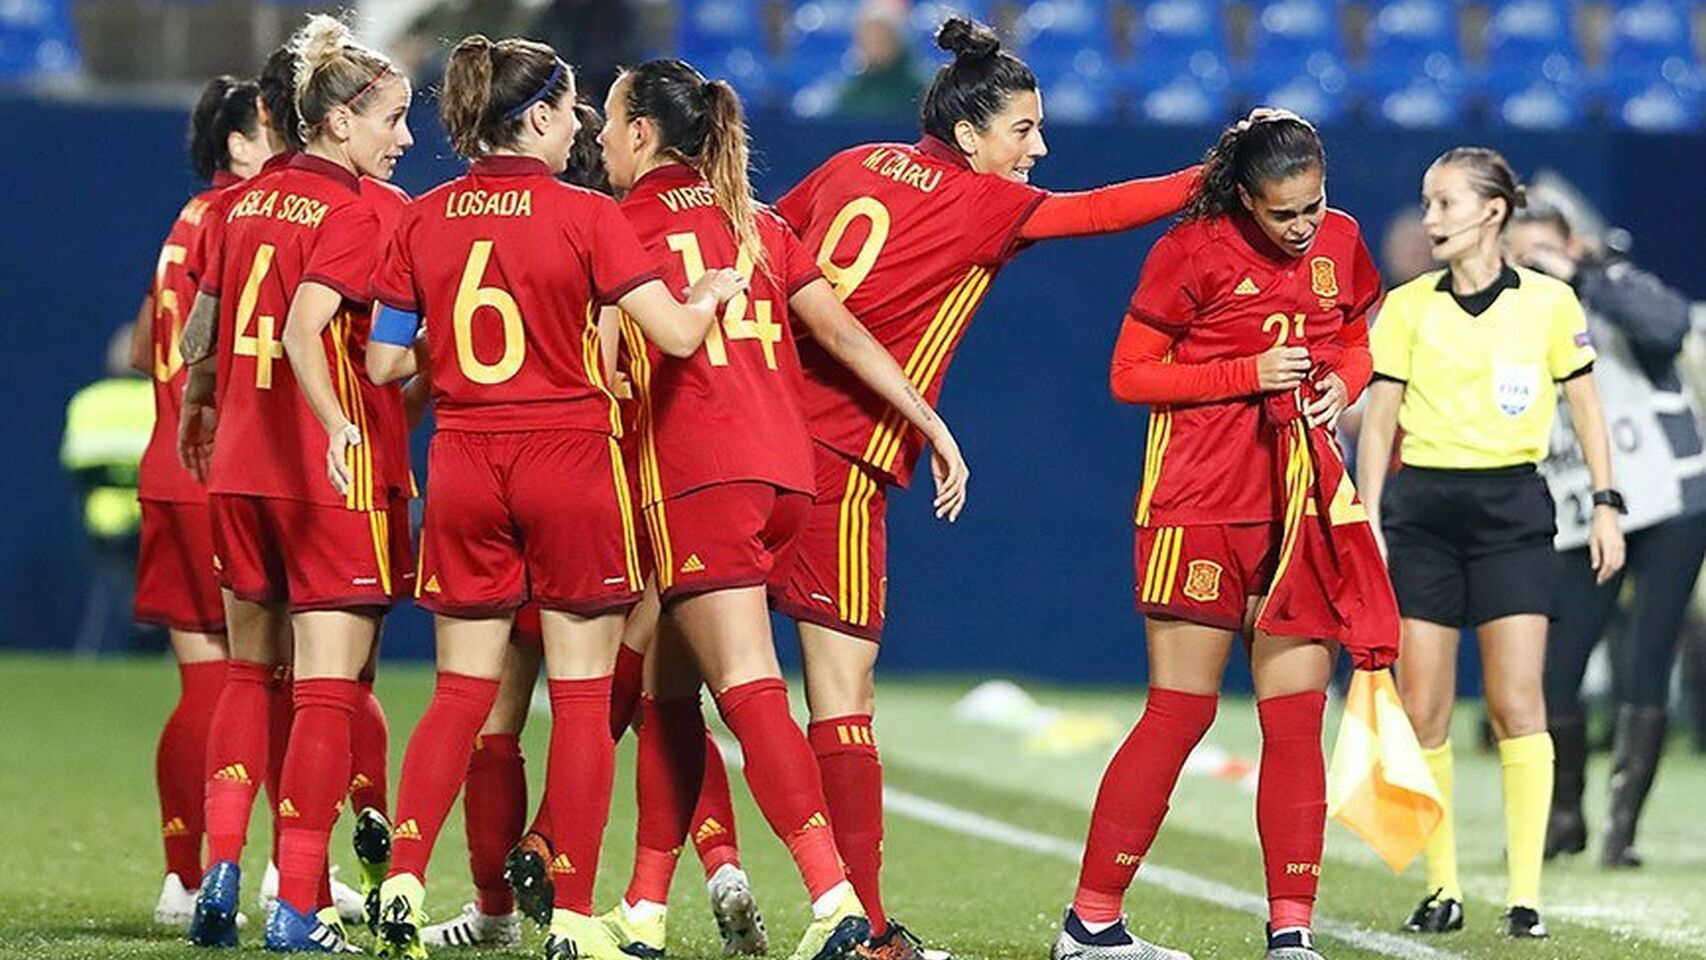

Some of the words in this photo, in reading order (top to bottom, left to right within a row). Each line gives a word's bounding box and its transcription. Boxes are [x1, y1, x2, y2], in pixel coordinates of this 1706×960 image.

[277, 194, 329, 228] SOSA
[445, 189, 532, 218] LOSADA
[657, 185, 716, 213] VIRG
[815, 196, 891, 303] 9
[233, 243, 284, 390] 4
[453, 240, 526, 385] 6
[666, 231, 783, 371] 14
